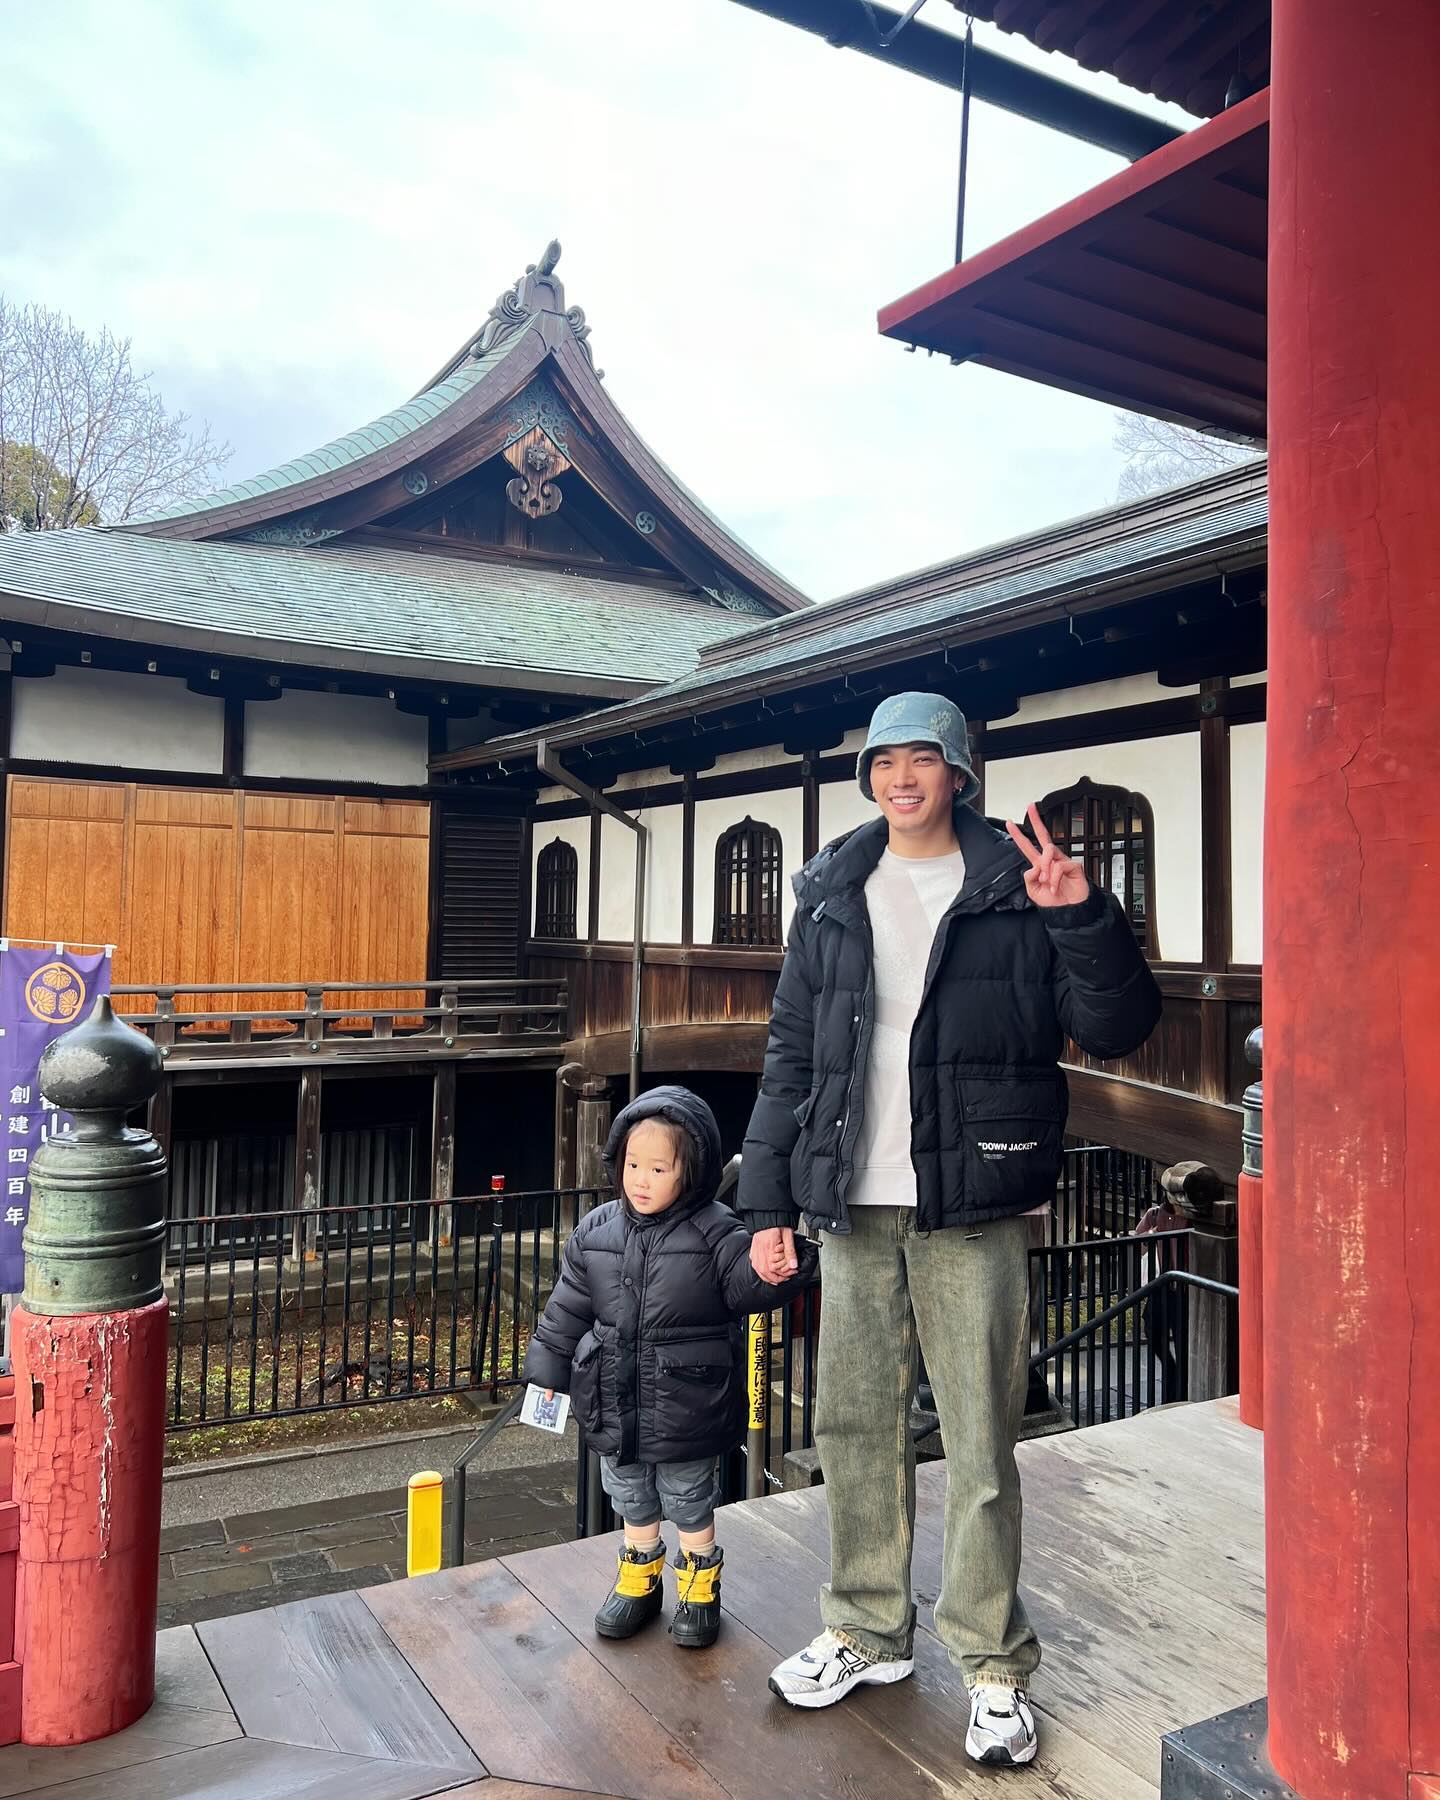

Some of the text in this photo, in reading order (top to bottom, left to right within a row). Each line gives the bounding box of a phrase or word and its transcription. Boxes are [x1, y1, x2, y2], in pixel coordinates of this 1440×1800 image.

[4, 1085, 31, 1226] 創建四百年
[978, 1142, 1037, 1152] "DOWN JACKET"
[753, 1336, 768, 1424] 段差に注意
